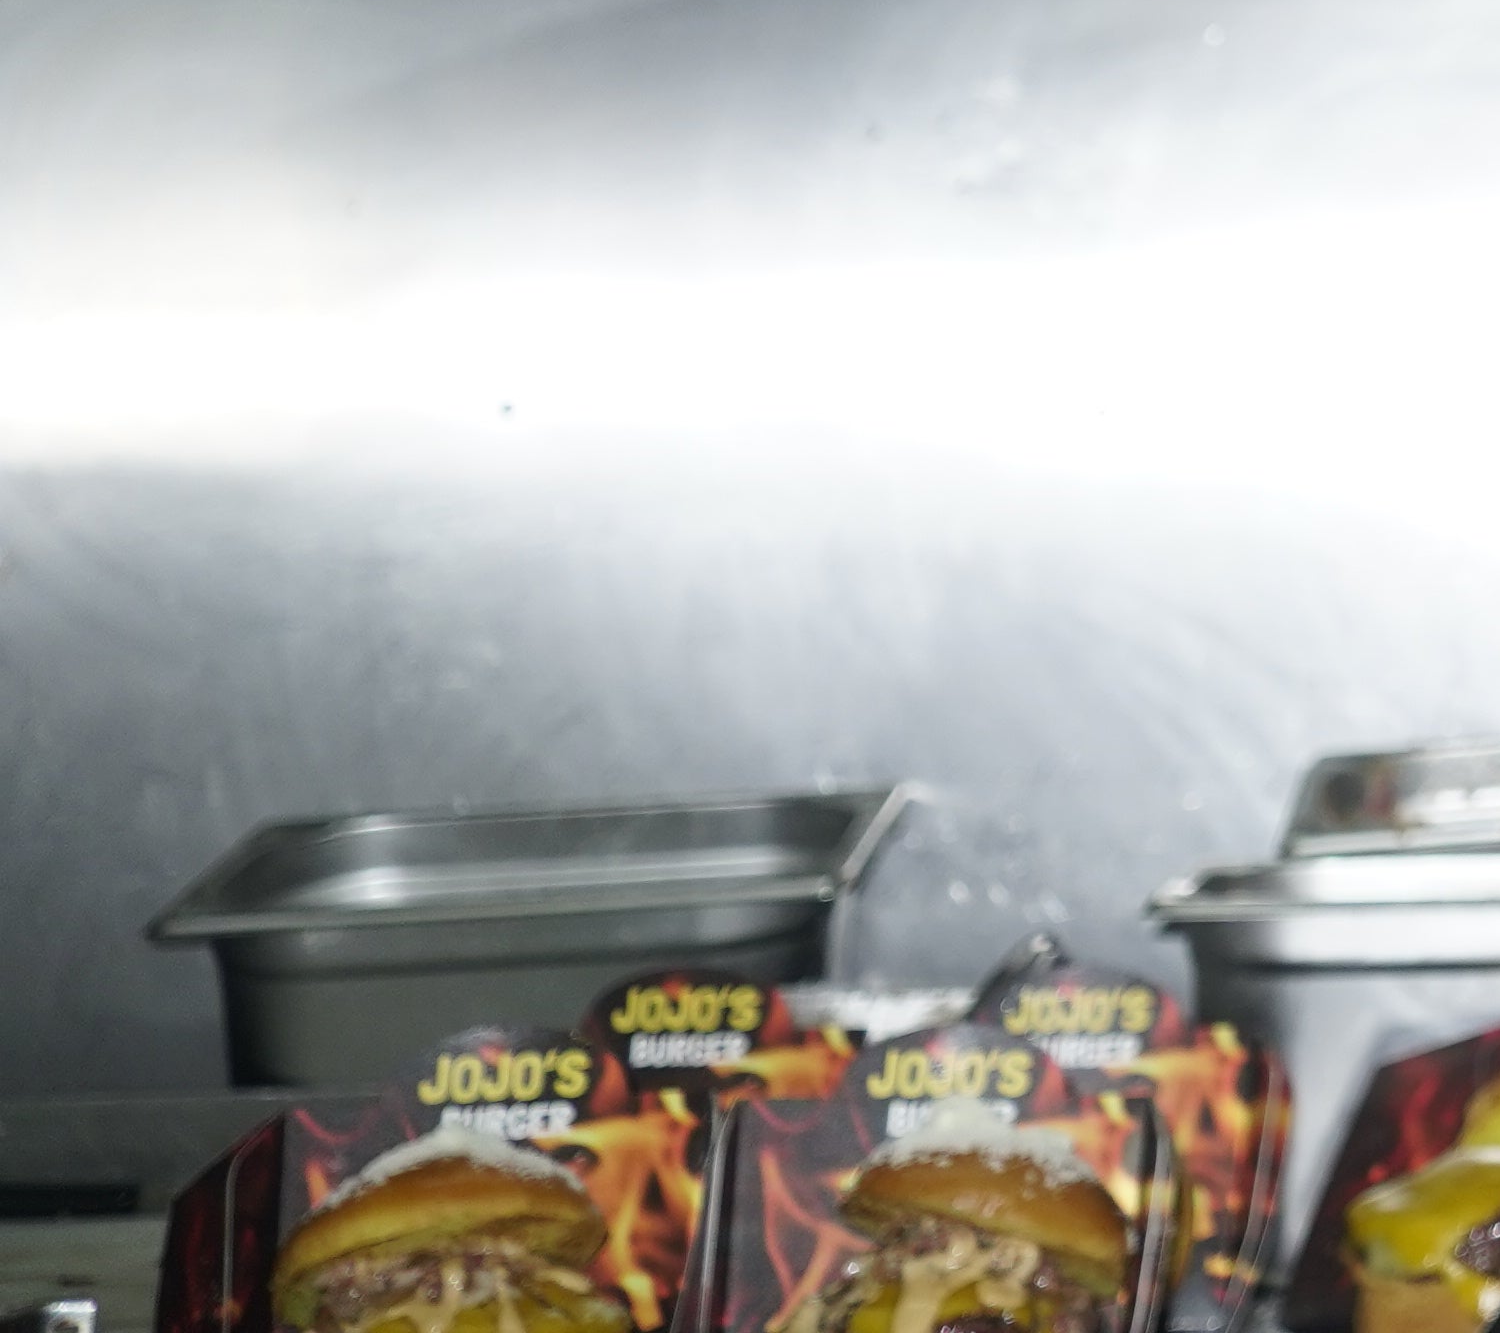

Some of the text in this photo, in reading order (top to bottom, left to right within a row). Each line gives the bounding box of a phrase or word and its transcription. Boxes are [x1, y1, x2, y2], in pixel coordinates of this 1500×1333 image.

[611, 985, 763, 1033] JOJO'S
[1004, 985, 1156, 1034] JOJO'S
[630, 1032, 752, 1069] BURGER
[866, 1049, 1034, 1100] JOJO'S
[417, 1048, 593, 1105] JOJO'S
